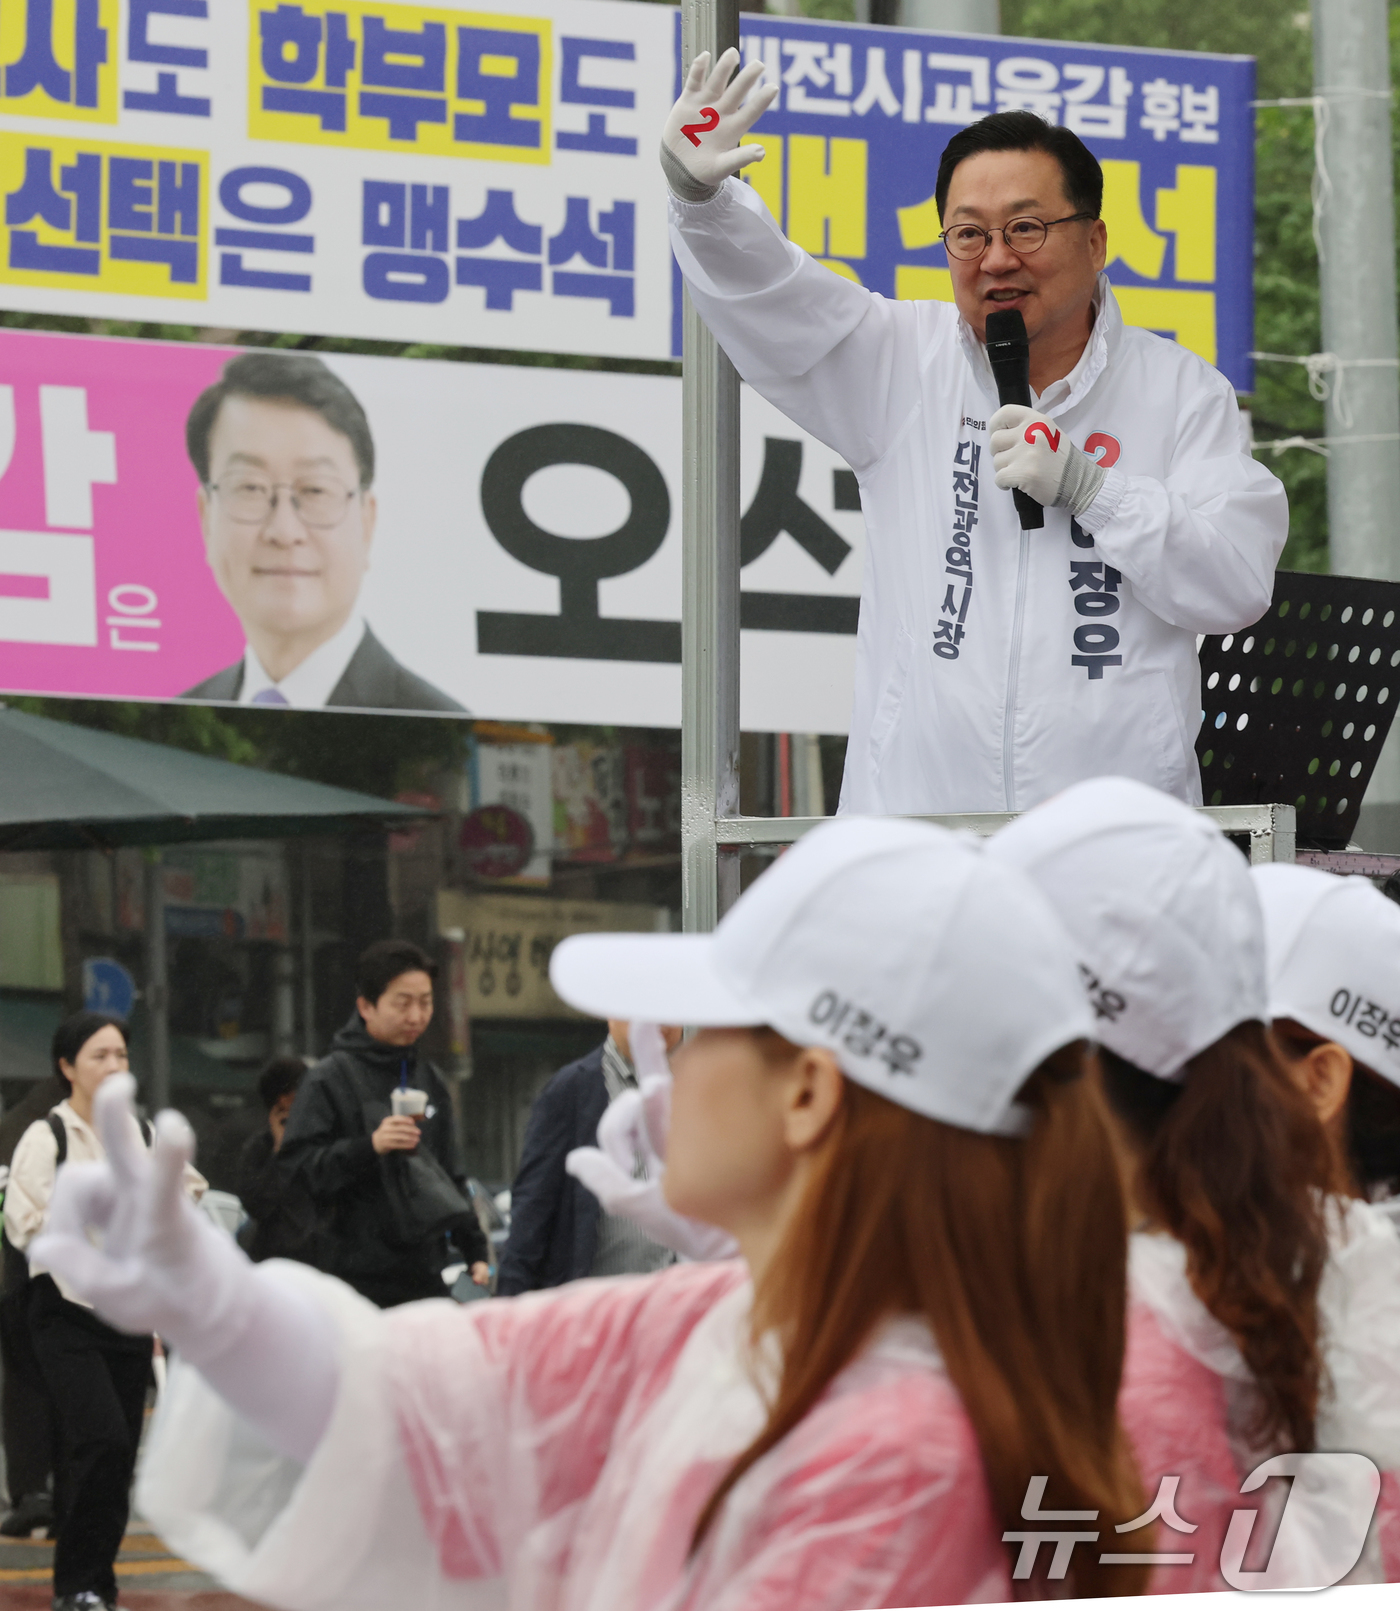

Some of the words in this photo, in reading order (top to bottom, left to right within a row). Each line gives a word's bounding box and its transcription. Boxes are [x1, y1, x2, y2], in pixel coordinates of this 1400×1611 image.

[259, 3, 639, 157] 학부모도
[1140, 77, 1219, 144] 후보
[680, 106, 721, 148] 2
[4, 147, 316, 294] 선택은
[361, 179, 637, 318] 맹수석
[1024, 421, 1061, 453] 2
[1068, 514, 1123, 680] 장우
[807, 990, 924, 1077] 이장우
